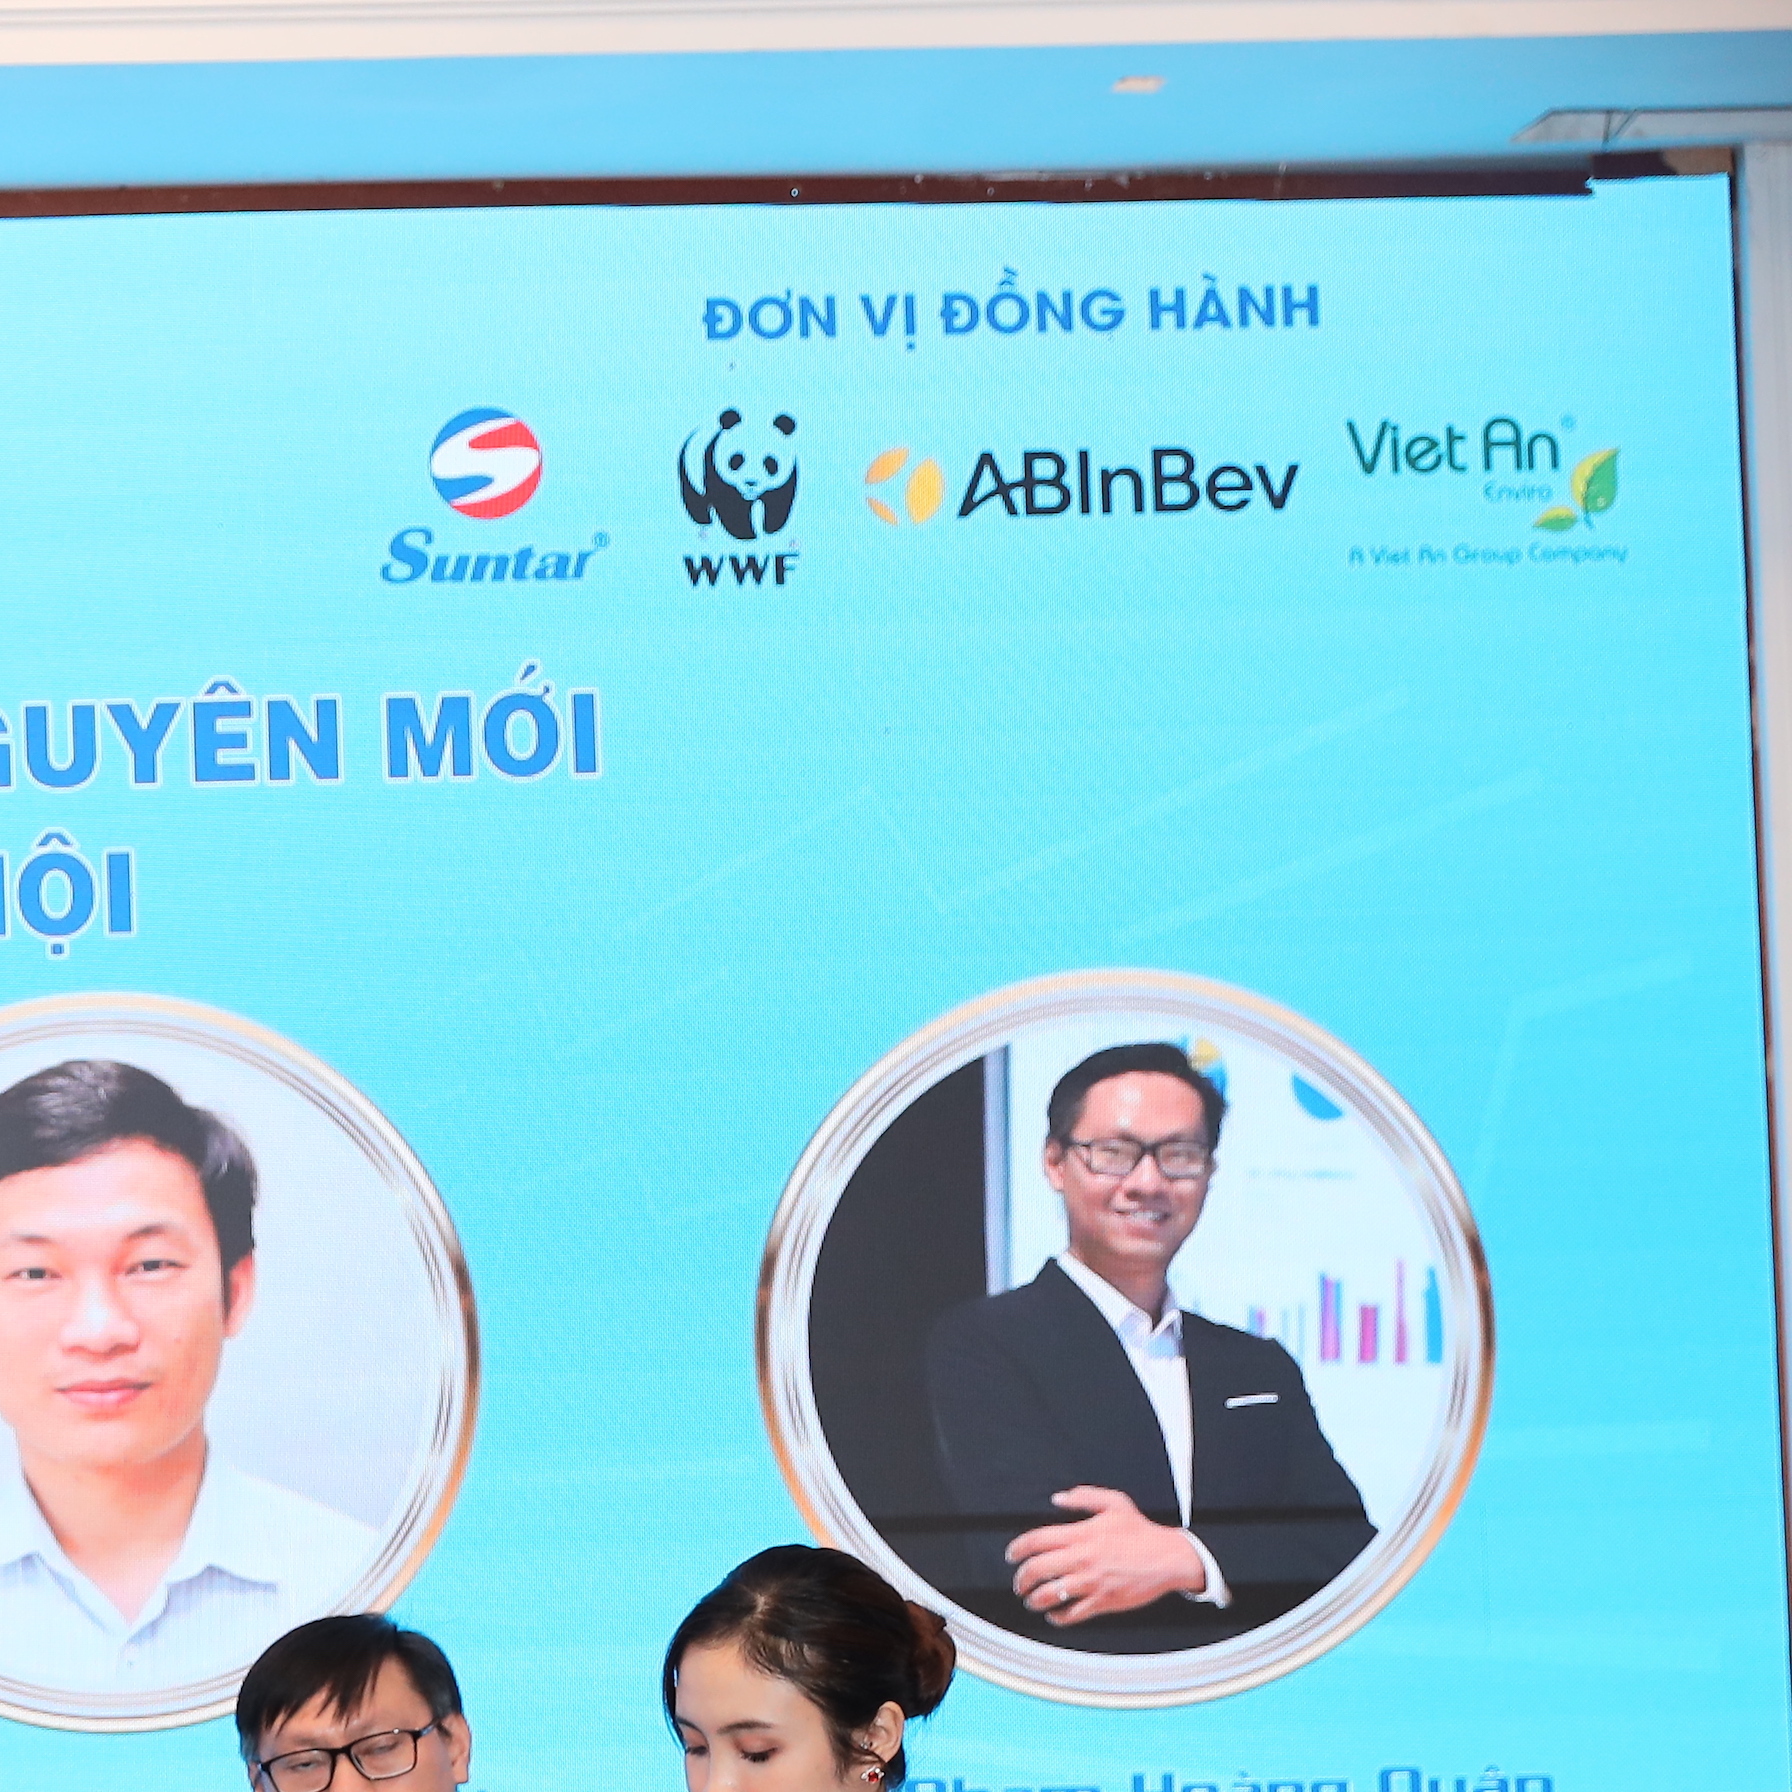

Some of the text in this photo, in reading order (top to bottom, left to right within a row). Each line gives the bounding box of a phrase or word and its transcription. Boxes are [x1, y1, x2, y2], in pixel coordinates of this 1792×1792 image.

[703, 267, 1320, 351] ĐƠN VỊ ĐỒNG HÀNH
[1347, 418, 1466, 474] Viet
[958, 447, 1299, 518] ABInBev
[682, 553, 800, 587] WWF
[382, 662, 602, 783] MỚI
